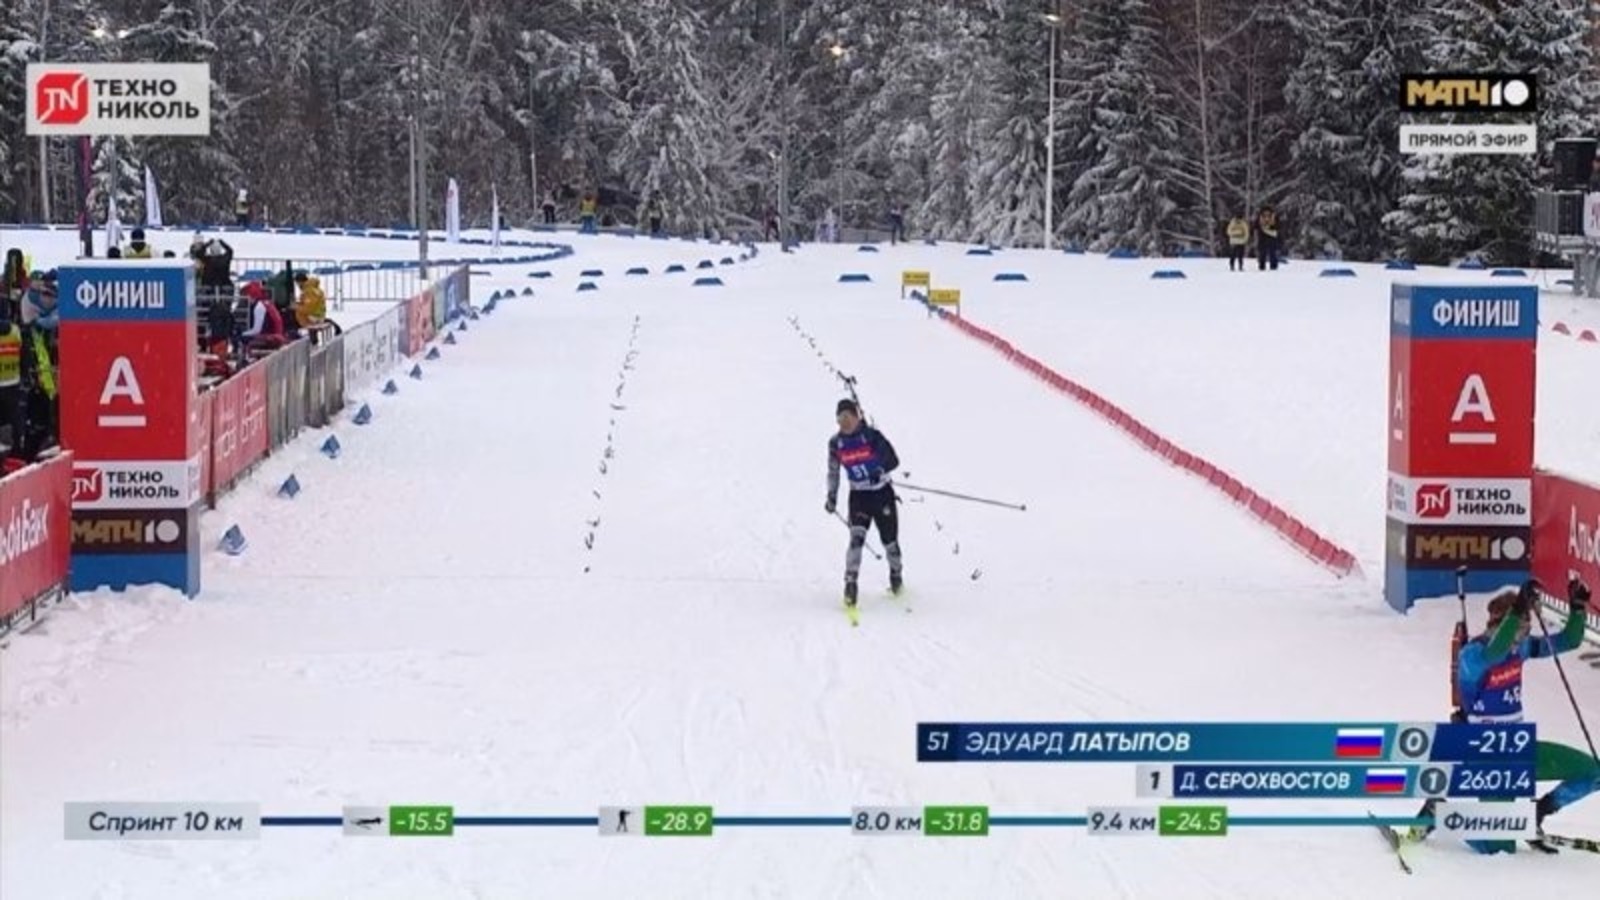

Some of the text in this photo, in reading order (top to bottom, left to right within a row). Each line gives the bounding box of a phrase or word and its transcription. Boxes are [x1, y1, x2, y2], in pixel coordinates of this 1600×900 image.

[76, 280, 165, 310] ФИНИШ
[1432, 299, 1520, 327] ФИНИШ
[106, 471, 163, 483] ТЕХНО
[109, 486, 180, 499] НИКОЛЬ
[1455, 488, 1512, 501] ТЕХНО
[1457, 503, 1527, 516] НИКОЛЬ
